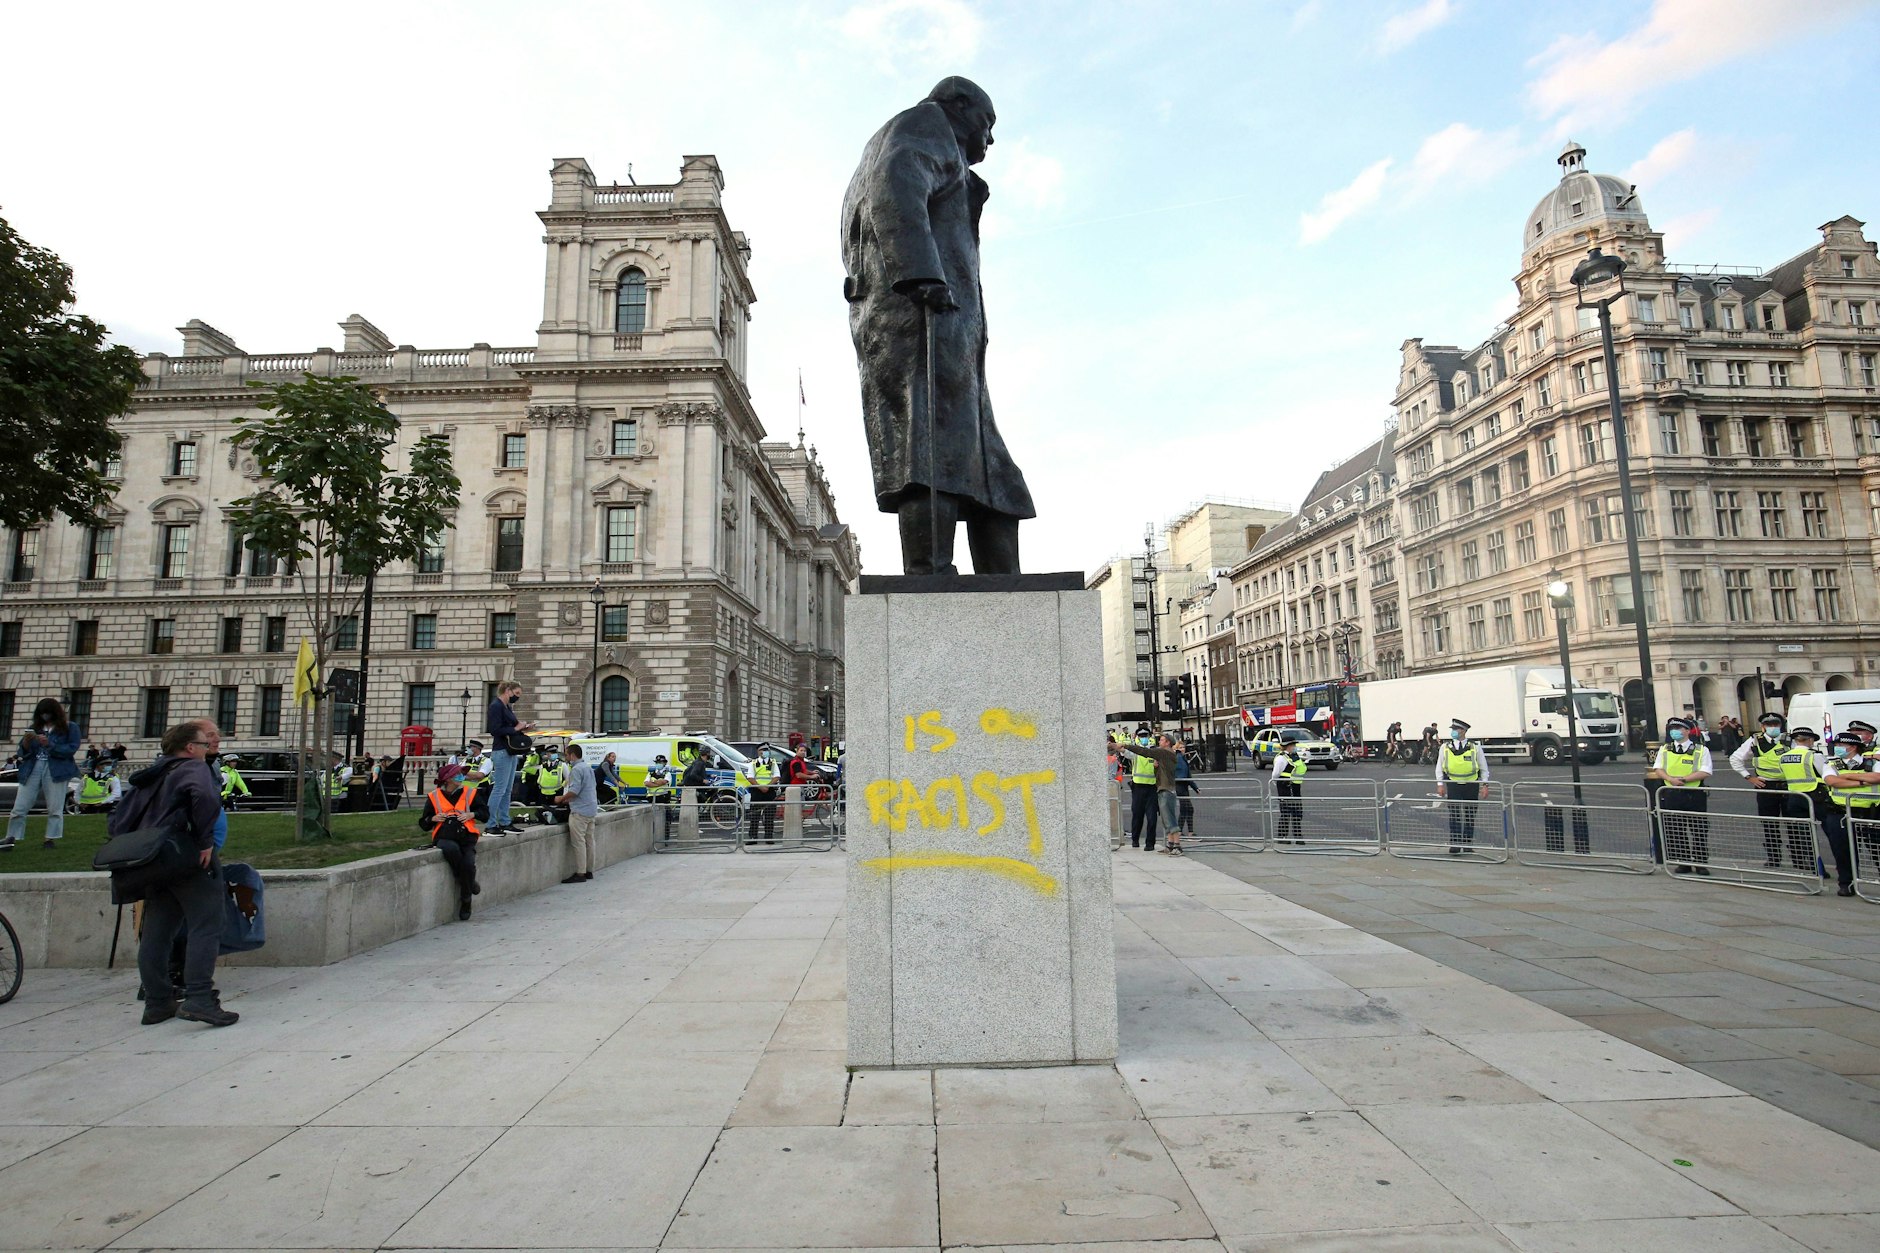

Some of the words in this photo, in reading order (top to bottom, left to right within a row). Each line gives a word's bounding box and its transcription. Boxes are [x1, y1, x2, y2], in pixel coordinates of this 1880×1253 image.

[904, 710, 957, 753] IS
[1782, 755, 1801, 763] POLICE
[864, 770, 1056, 859] RACIST
